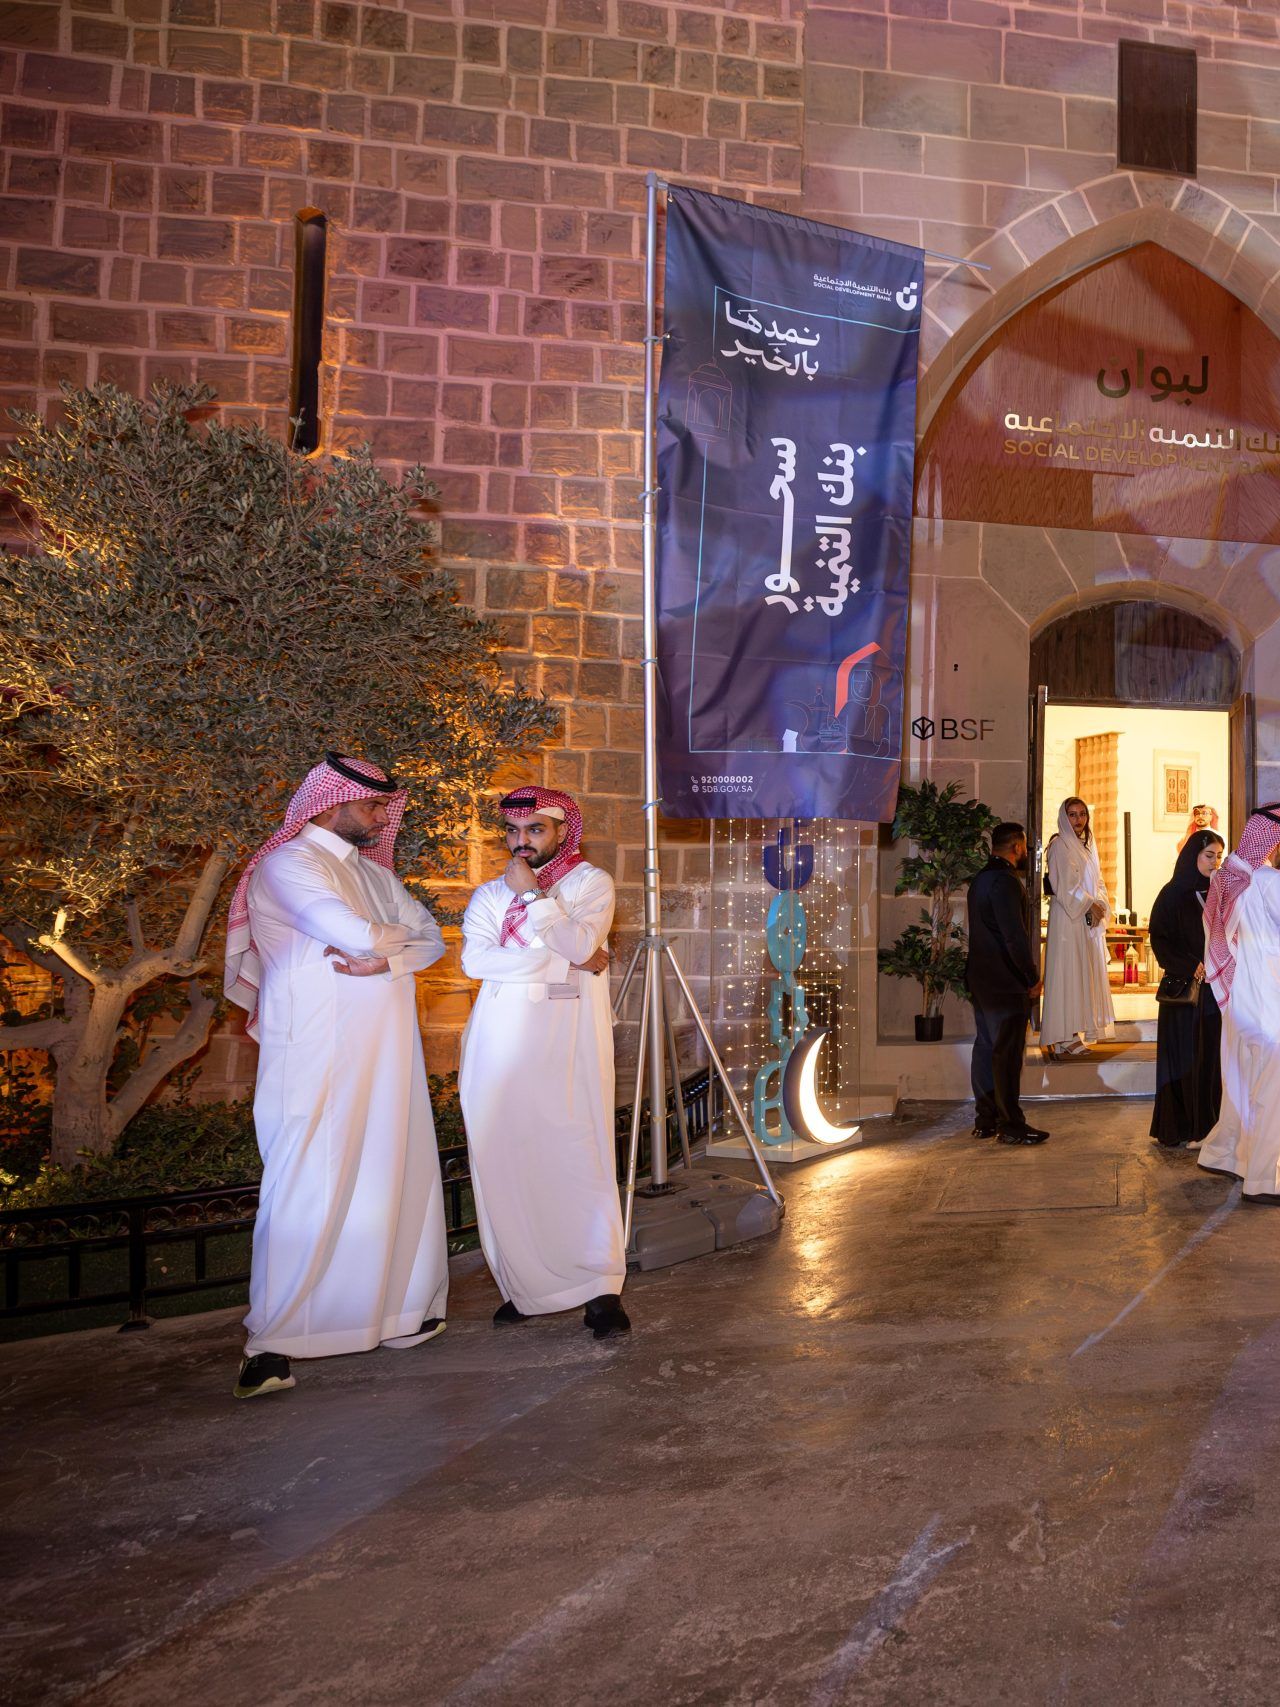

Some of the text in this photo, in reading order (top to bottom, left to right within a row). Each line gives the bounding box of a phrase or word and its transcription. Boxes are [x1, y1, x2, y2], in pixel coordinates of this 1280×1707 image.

[813, 281, 892, 302] SOCIAL DEVELOPMENT BANK
[1096, 348, 1209, 406] ليوان
[1149, 424, 1241, 451] التنمية
[1004, 439, 1080, 460] SOCIAL
[1086, 446, 1233, 474] DEVELOPMENT
[803, 442, 868, 617] بنك التنمية
[941, 718, 995, 741] BSF
[701, 775, 753, 784] 920008002
[702, 785, 753, 793] SDB.GOV.SA
